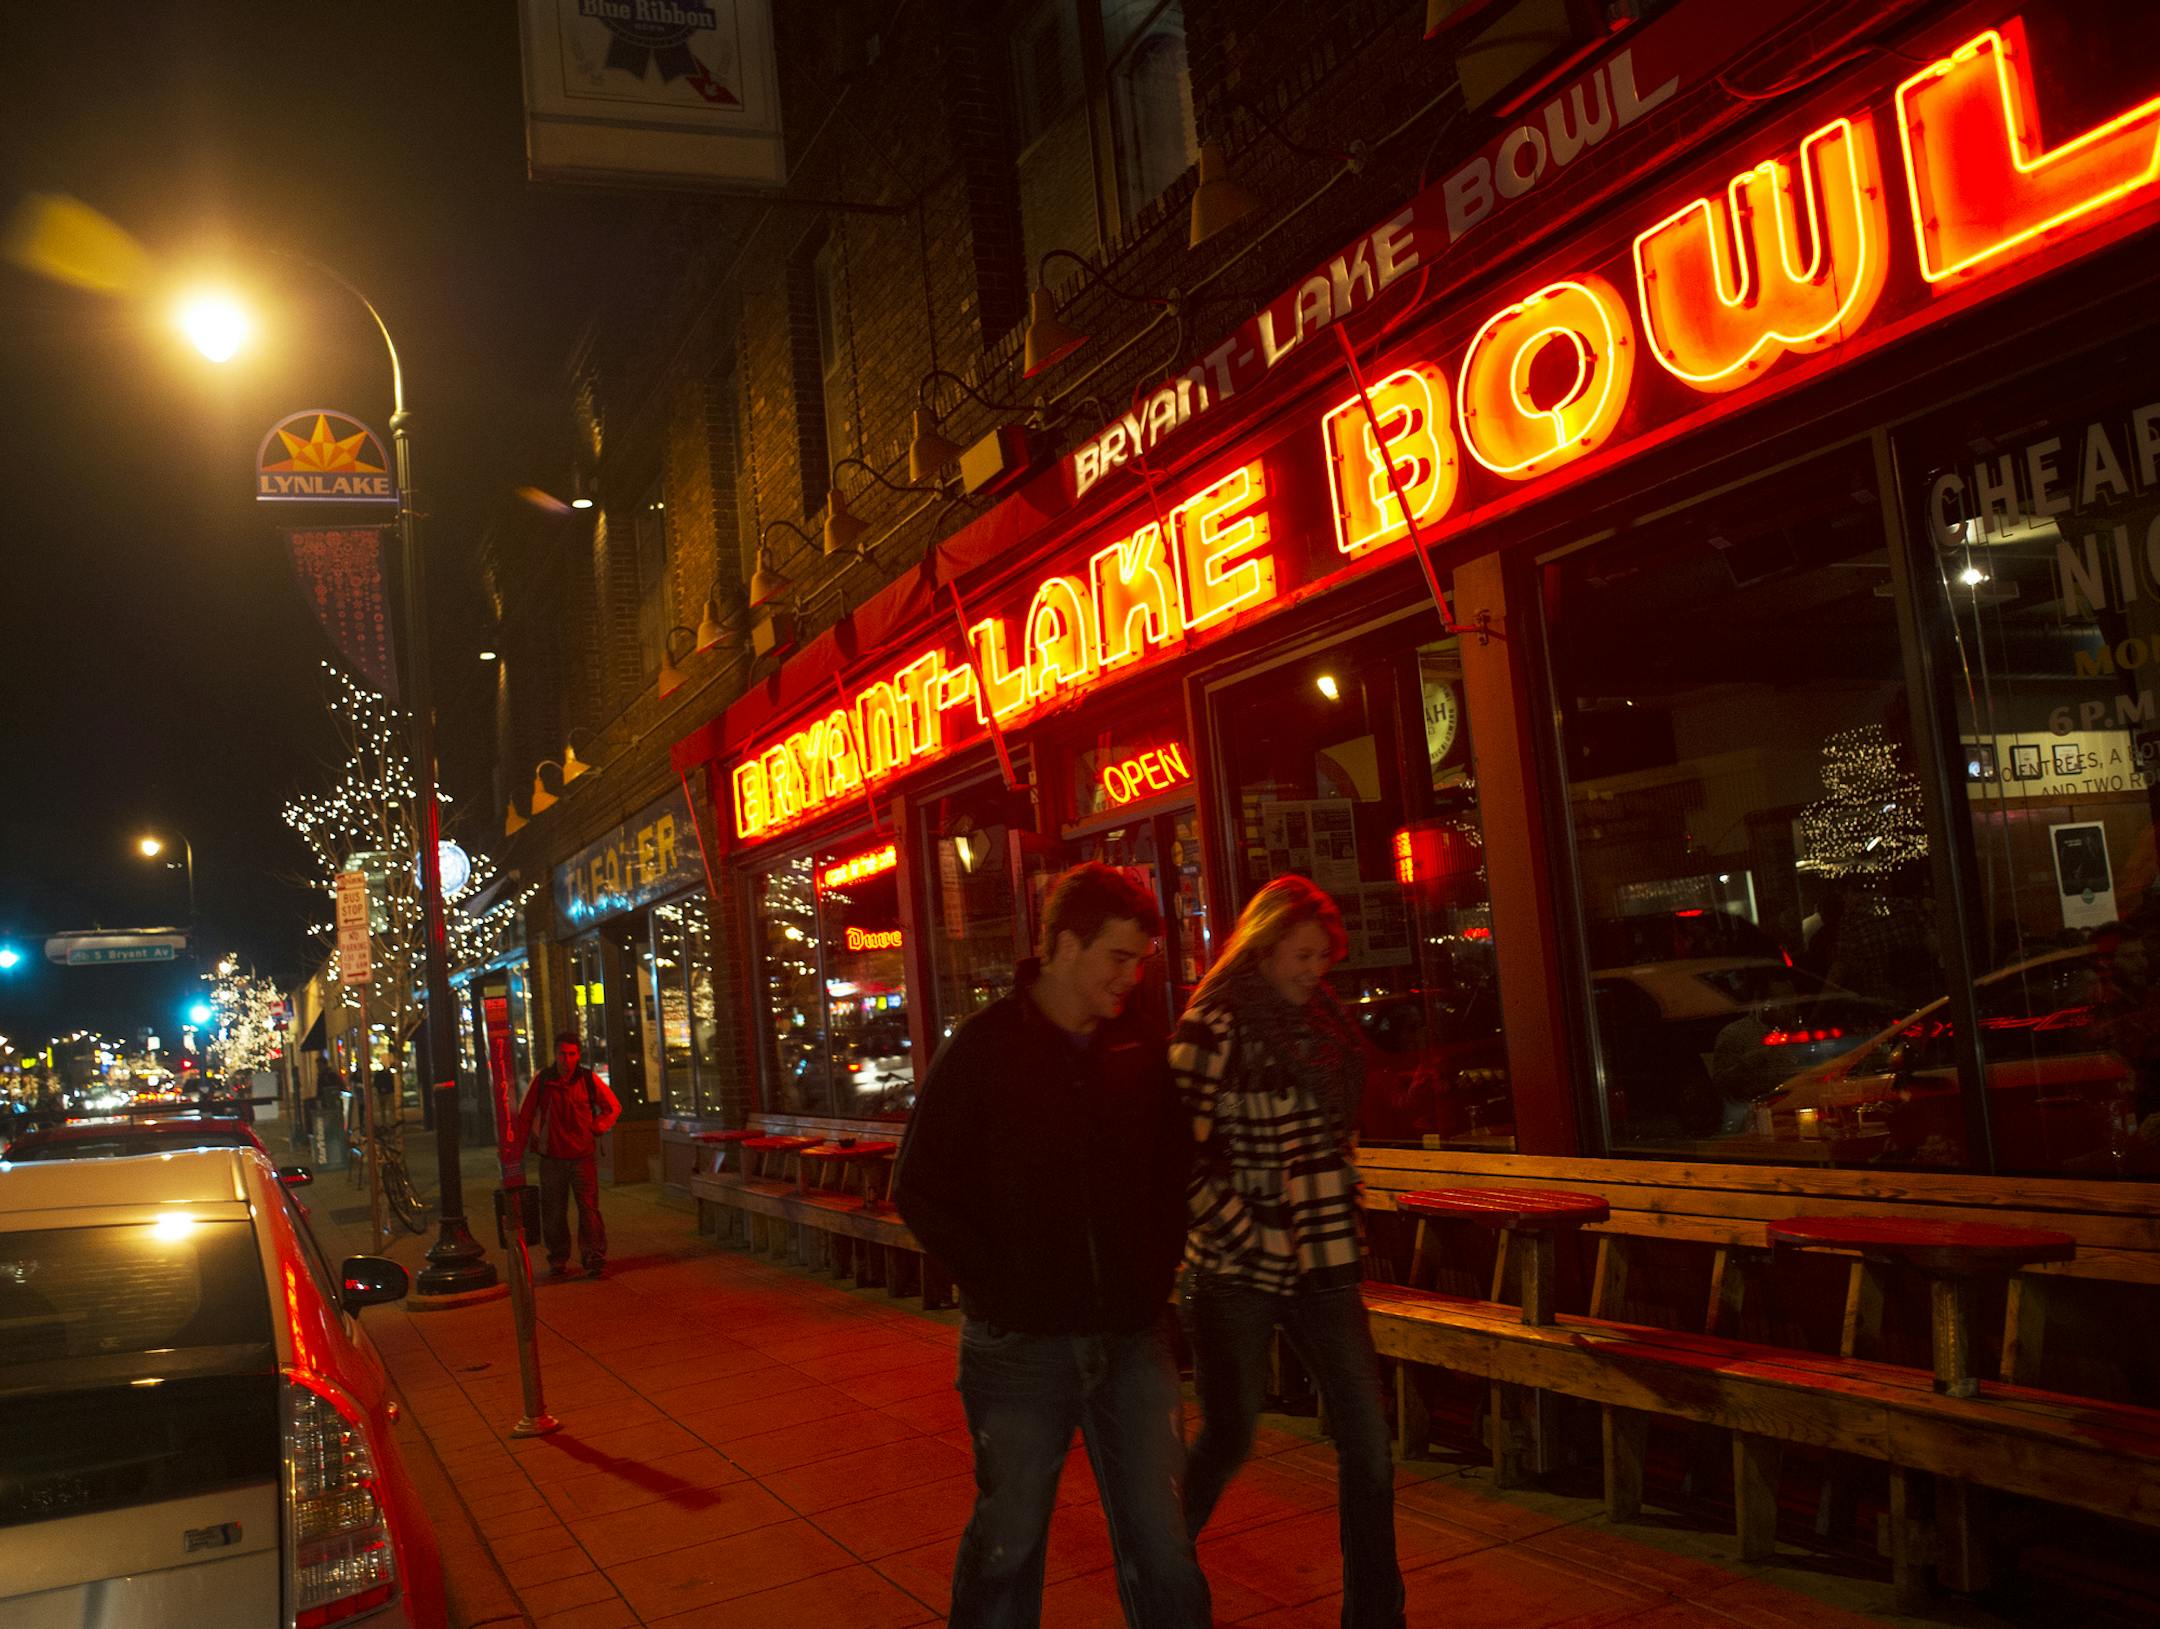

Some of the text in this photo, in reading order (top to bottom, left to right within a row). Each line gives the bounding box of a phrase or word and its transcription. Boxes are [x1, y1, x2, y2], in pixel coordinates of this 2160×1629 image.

[584, 0, 714, 28] Blue Ribbon
[1441, 48, 1679, 245] BOWL
[732, 15, 2160, 839] BRYANT-LAKE BOWL
[260, 474, 390, 495] LYNLAKE
[2056, 511, 2160, 618] NI
[2109, 747, 2123, 765] A
[1103, 743, 1191, 805] OPEN
[2083, 775, 2125, 794] TWO
[2130, 767, 2160, 789] RO
[342, 903, 363, 917] STOP
[343, 892, 361, 904] BUS
[109, 949, 148, 960] Bryant
